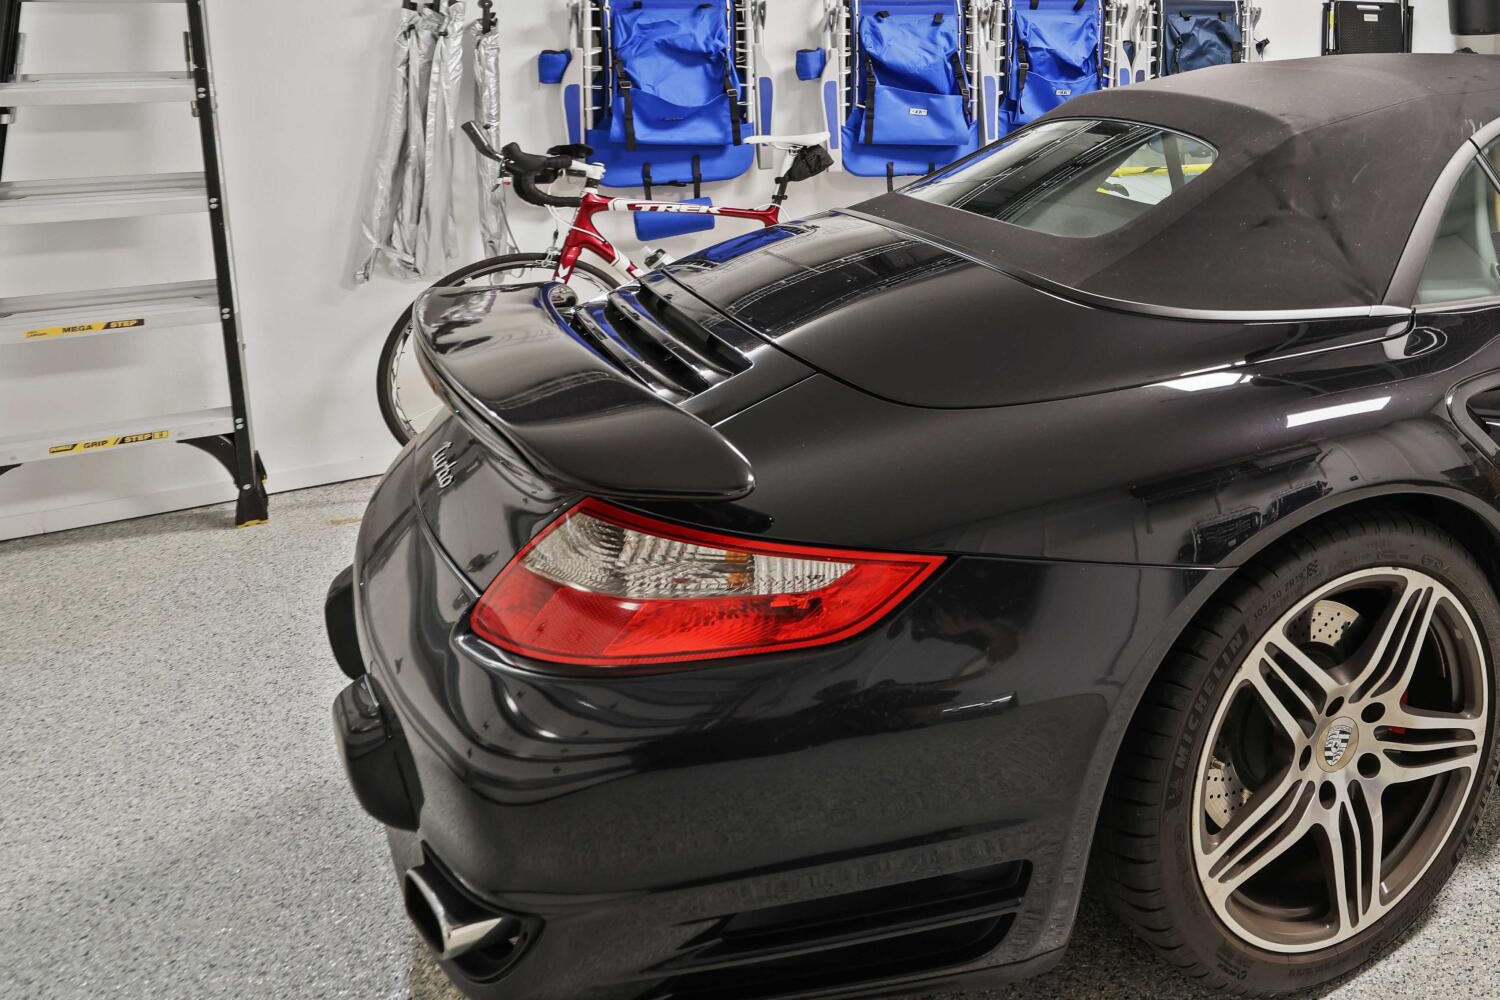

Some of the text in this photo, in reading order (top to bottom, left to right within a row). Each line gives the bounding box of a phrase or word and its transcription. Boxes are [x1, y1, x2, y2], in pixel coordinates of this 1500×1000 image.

[635, 203, 720, 214] TREK
[62, 319, 137, 334] MEGA STEP
[83, 440, 109, 449] GRIP
[122, 433, 150, 443] STEP
[1175, 632, 1246, 770] MICHELIN
